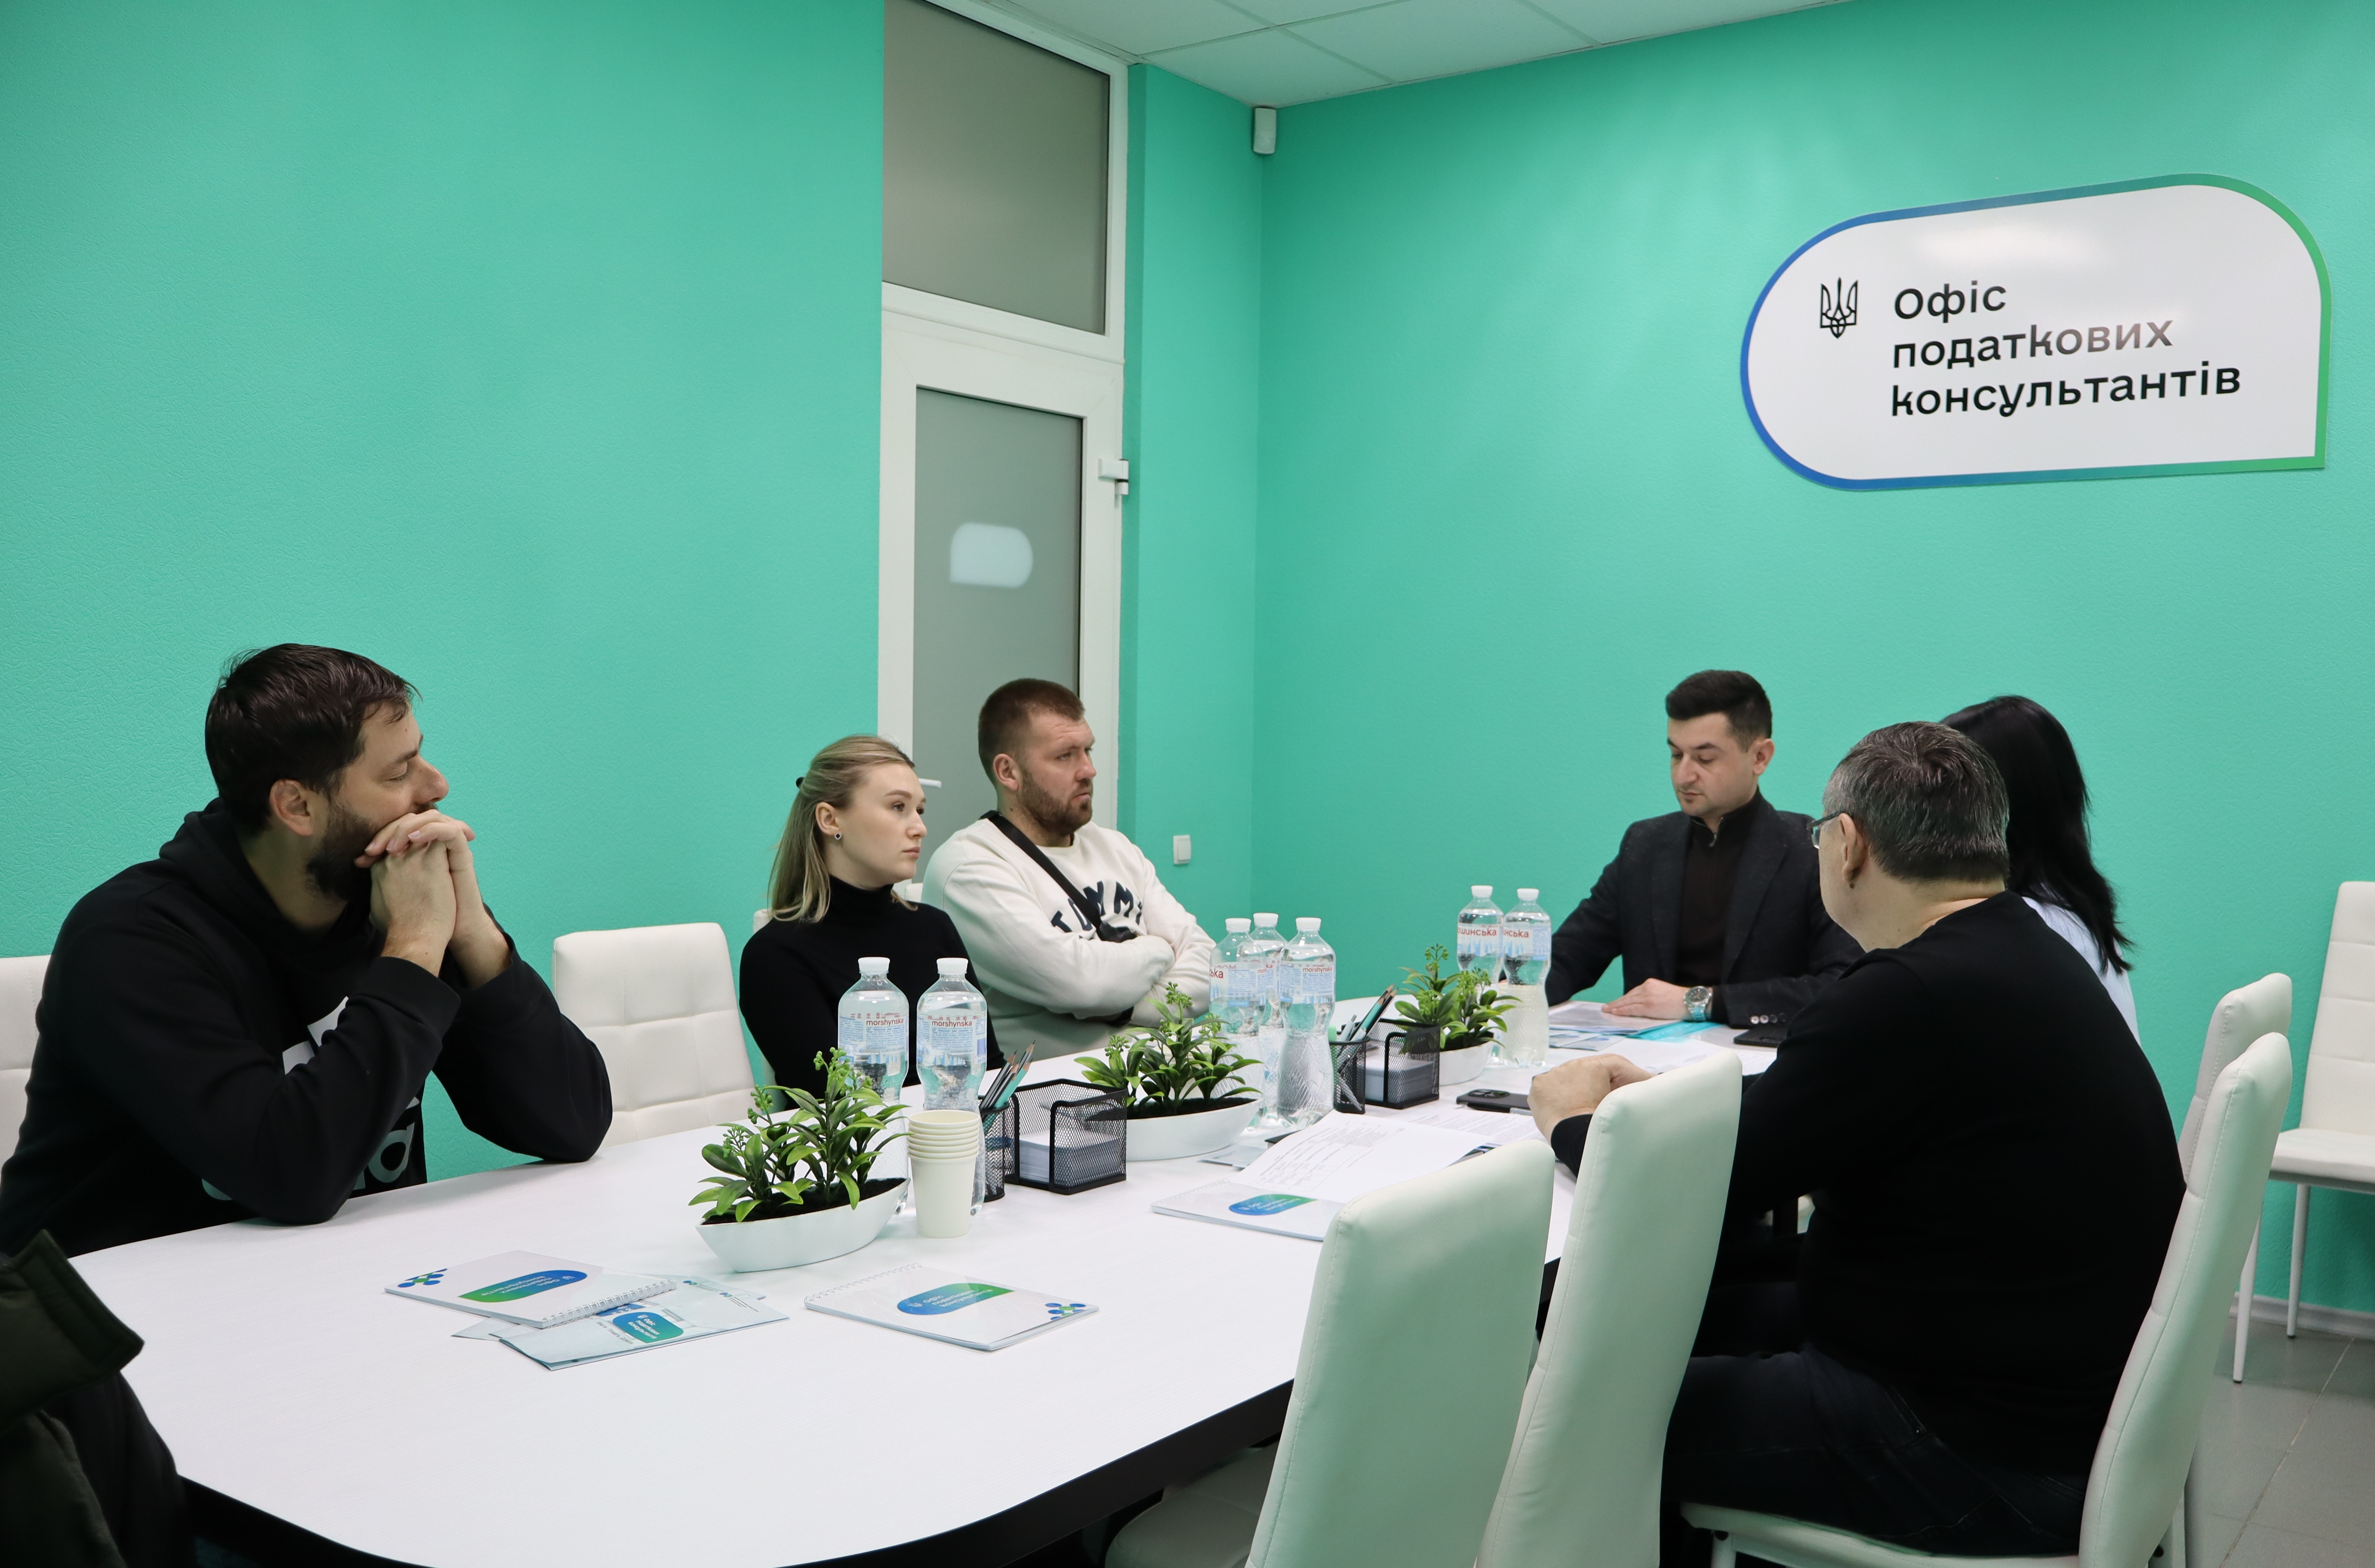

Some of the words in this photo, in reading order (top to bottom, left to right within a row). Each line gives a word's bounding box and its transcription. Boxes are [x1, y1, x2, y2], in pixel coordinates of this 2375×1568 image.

[1894, 280, 2007, 324] Офіс
[1893, 320, 2174, 370] податкових
[1891, 360, 2241, 418] консультантів
[866, 1018, 904, 1026] morshynska
[932, 1020, 972, 1028] morshynska
